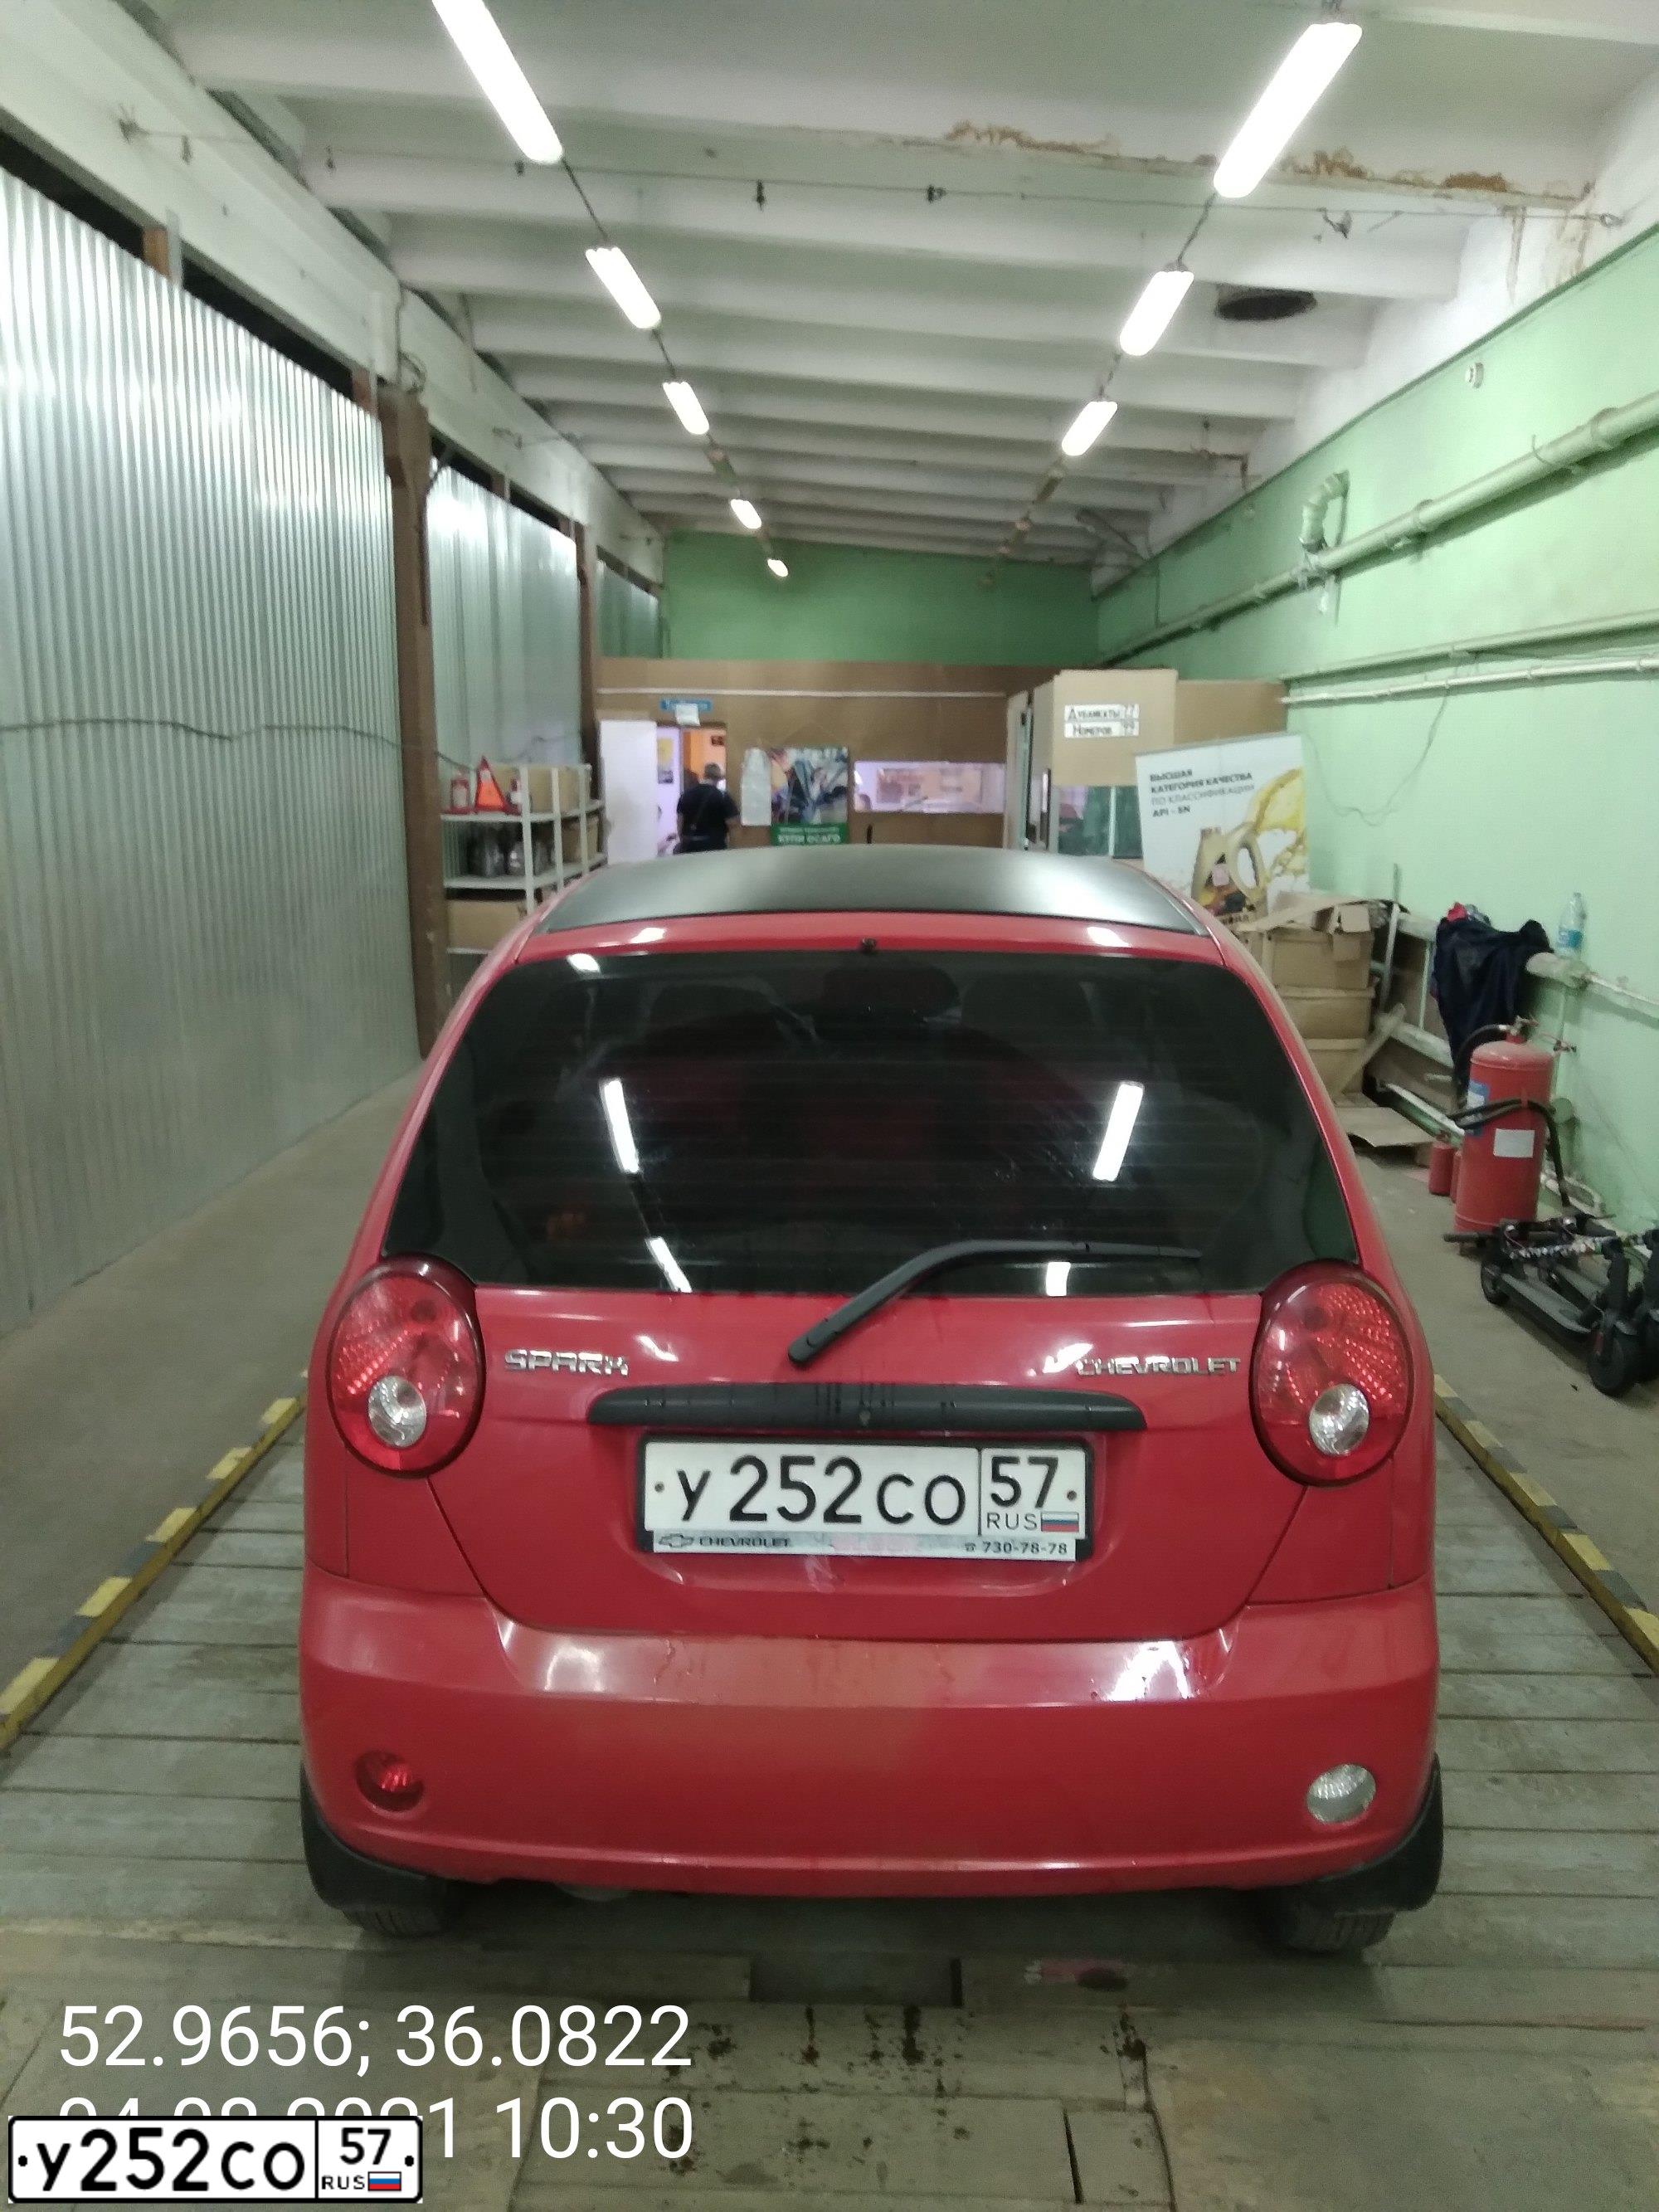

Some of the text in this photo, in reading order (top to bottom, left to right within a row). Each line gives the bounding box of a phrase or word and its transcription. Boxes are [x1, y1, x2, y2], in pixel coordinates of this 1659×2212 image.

[1150, 768, 1193, 782] ВЫСШАЯ
[1151, 772, 1253, 793] КАТЕГОРИЯ КАЧЕСТВА
[505, 1349, 629, 1376] SPARK
[1076, 1355, 1241, 1376] CHEVROLET
[990, 1455, 1059, 1508] 57
[986, 1512, 1038, 1531] RUS
[699, 1537, 791, 1549] CHEVROLET
[982, 1541, 1068, 1556] 730-78-78
